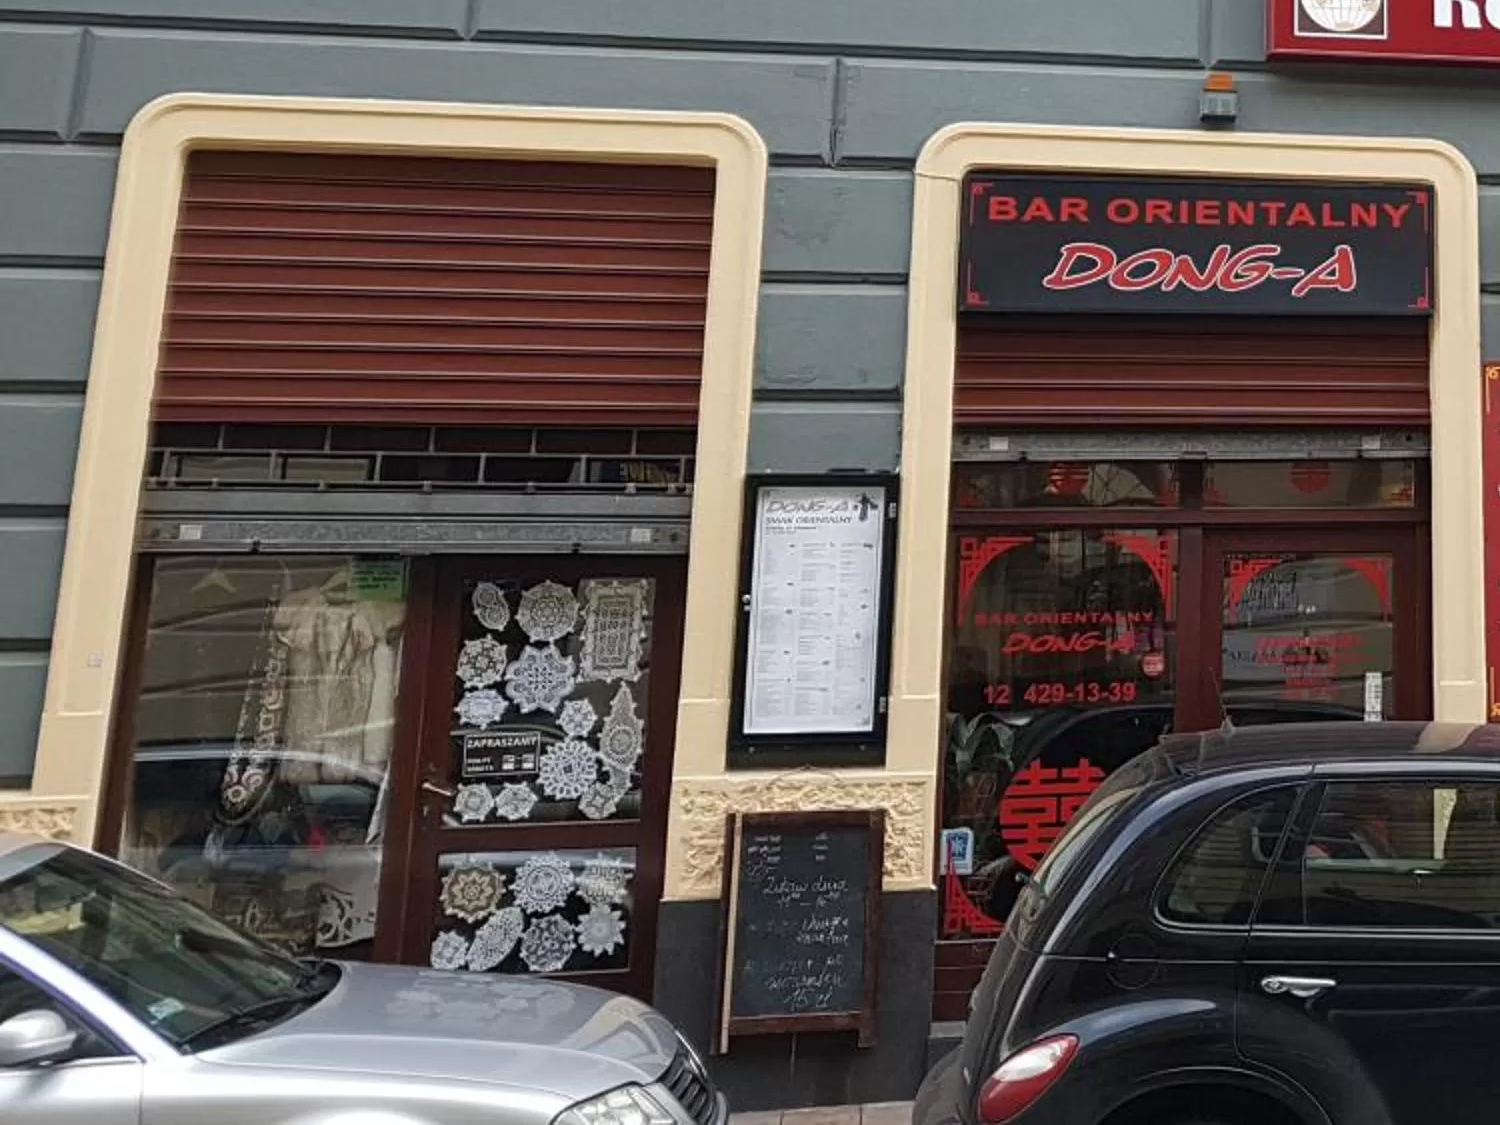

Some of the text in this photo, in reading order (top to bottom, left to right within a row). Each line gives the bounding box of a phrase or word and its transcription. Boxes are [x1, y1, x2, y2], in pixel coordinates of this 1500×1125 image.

[988, 196, 1411, 228] BAR ORIENTALNY
[1042, 241, 1357, 296] DONG-A
[975, 611, 1153, 626] BAR ORIENTALNY
[1002, 630, 1134, 654] DONG-A
[983, 682, 1137, 704] 12 429-13-39
[467, 736, 537, 748] ZAPRASZAMY
